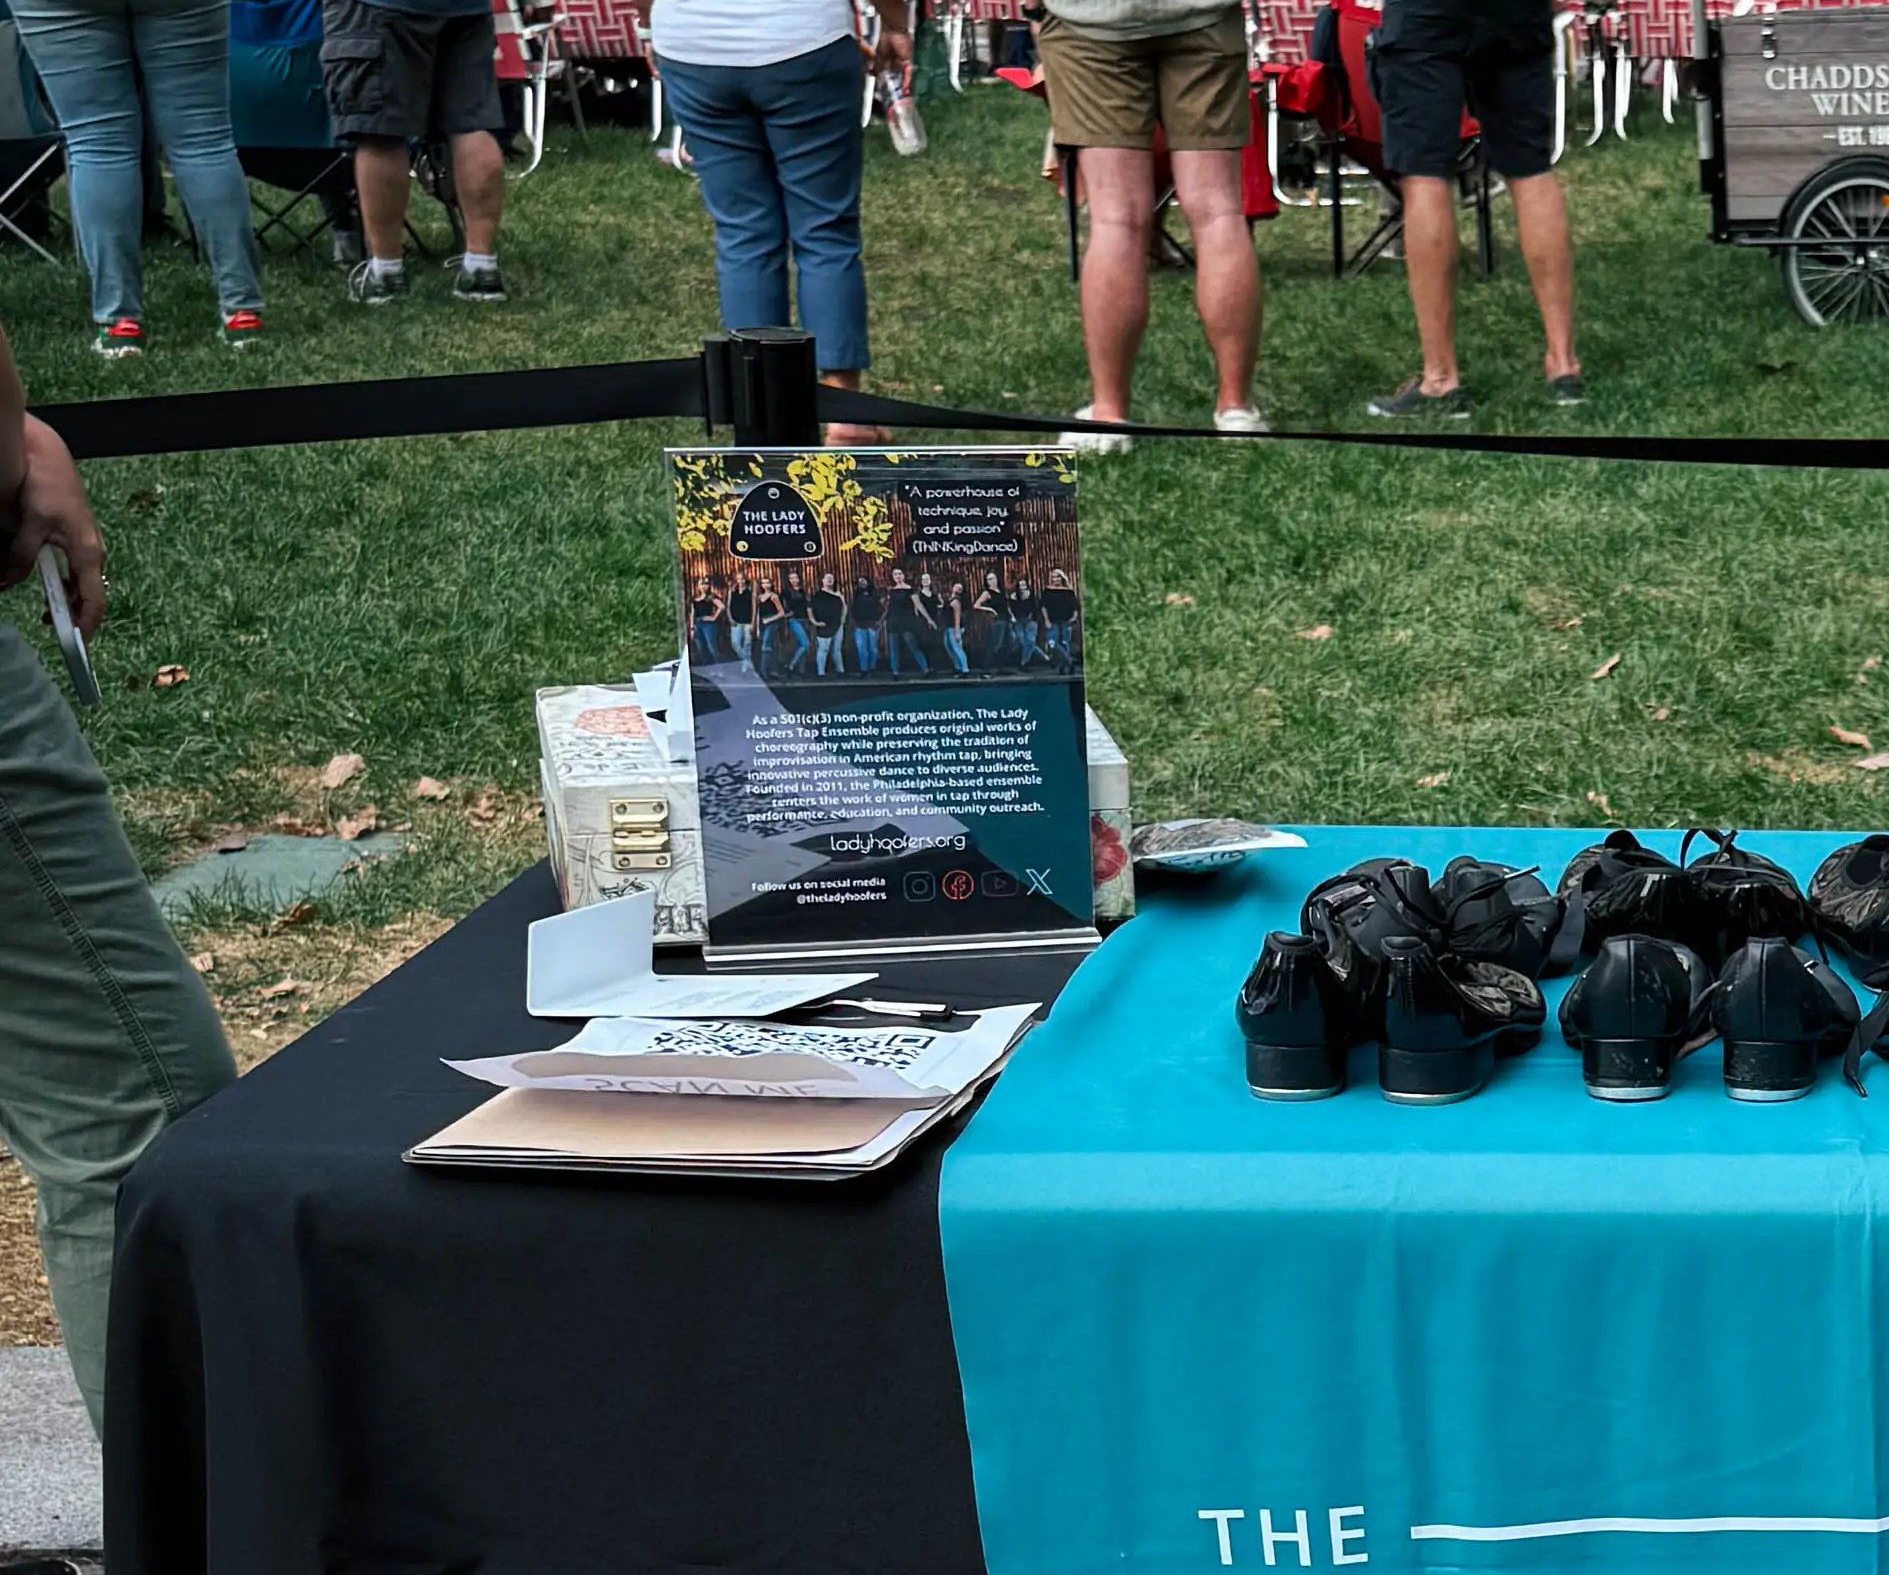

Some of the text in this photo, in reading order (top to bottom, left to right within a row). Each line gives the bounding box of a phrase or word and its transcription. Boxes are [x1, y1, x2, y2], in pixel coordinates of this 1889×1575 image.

[925, 485, 1003, 501] powerhouse
[1007, 485, 1021, 497] of
[743, 510, 806, 522] THE LADY
[744, 523, 806, 536] HOOFERS
[923, 523, 950, 535] and
[752, 714, 767, 725] As
[769, 715, 778, 725] a
[780, 713, 832, 725] 501(c)(3)
[834, 711, 894, 724] non-profit
[976, 708, 998, 720] The
[1000, 708, 1029, 721] Lady
[745, 720, 1037, 740] Hoofers Tap Ensemble produces original works of
[754, 733, 1030, 754] choreography while preserving the tradition of
[753, 748, 1033, 769] improvisation in American rhythm tap, bringing
[747, 761, 1040, 781] innovative percussive dance to diverse audiences.
[745, 782, 799, 795] Founded
[801, 782, 813, 792] in
[850, 780, 870, 791] the
[872, 776, 984, 790] Philadelphia-based
[986, 774, 1043, 786] ensemble
[771, 788, 1020, 808] centers the work of women in tap through
[895, 805, 918, 817] and
[920, 803, 988, 816] community
[989, 801, 1045, 813] outreach.
[751, 876, 886, 894] Follow us on social media
[796, 890, 888, 906] @theladyhoofers
[1197, 1506, 1370, 1568] THE
